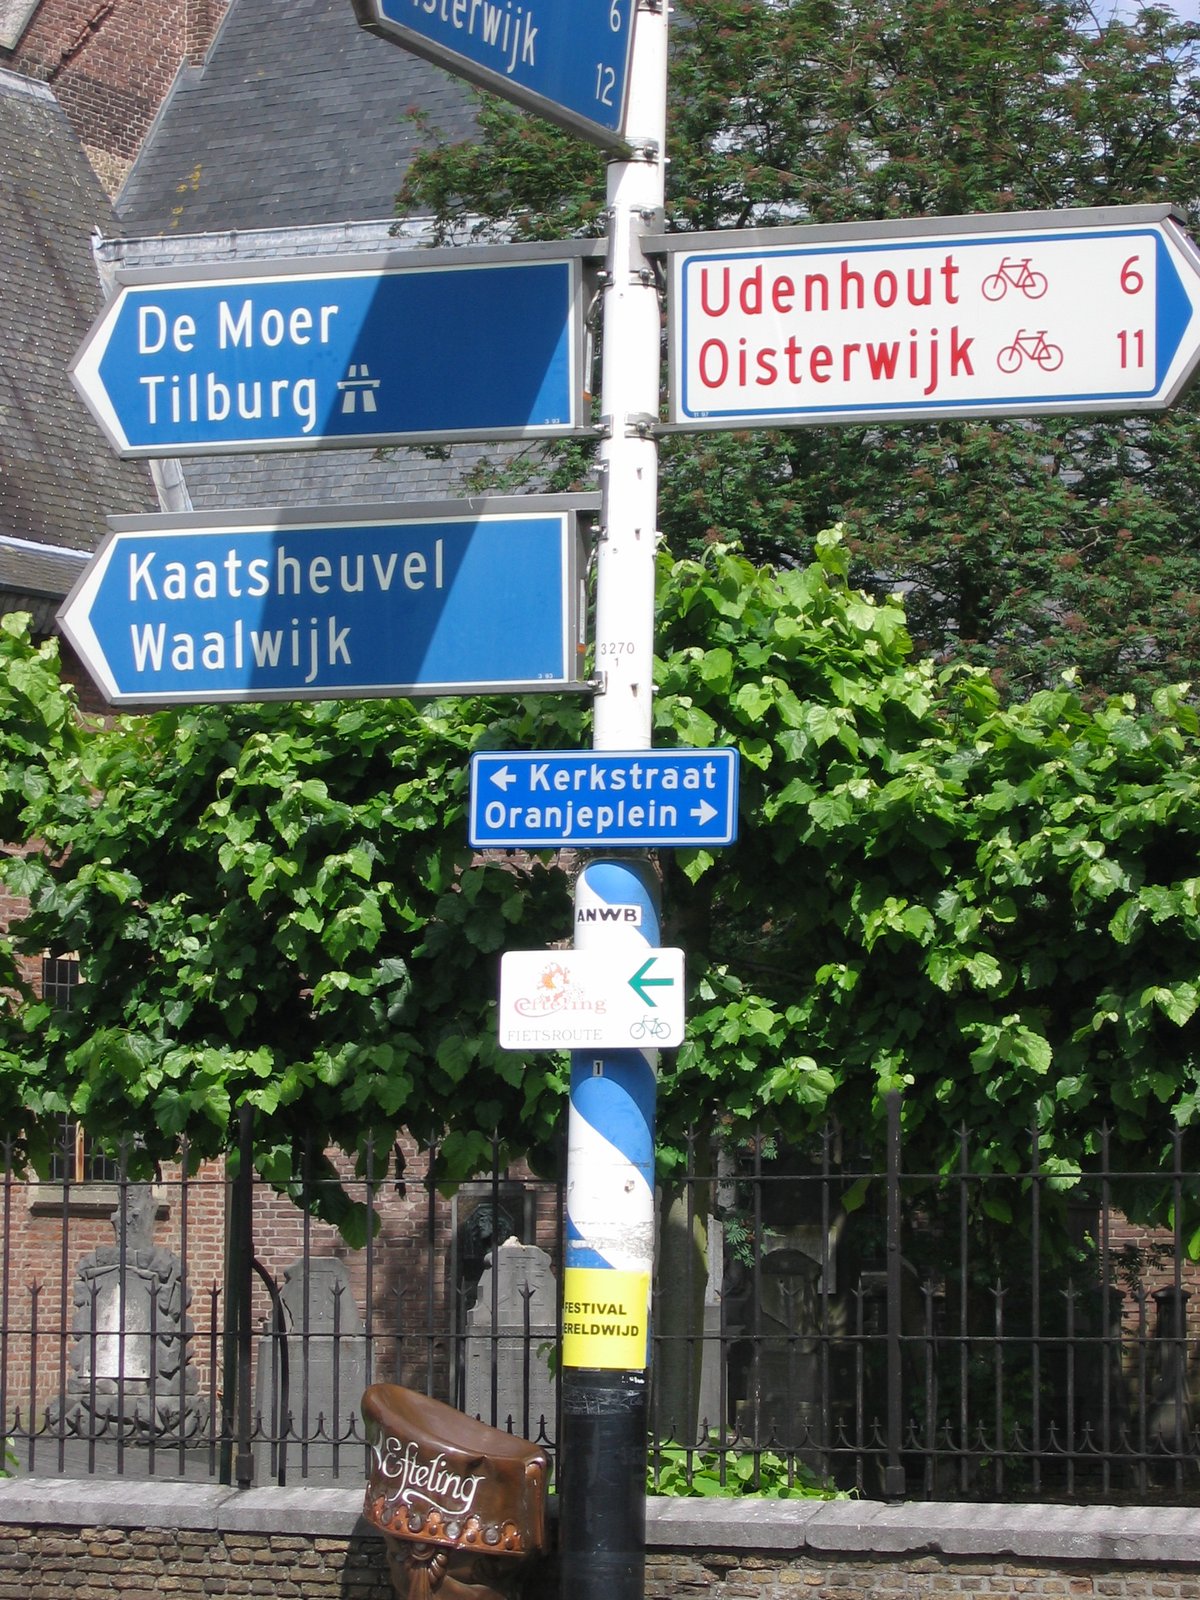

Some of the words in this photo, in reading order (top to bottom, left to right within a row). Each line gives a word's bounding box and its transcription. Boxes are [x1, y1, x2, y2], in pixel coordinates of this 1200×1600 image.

[609, 0, 622, 32] 6
[594, 62, 616, 107] 12
[700, 254, 960, 318] Udenhout
[1120, 254, 1145, 295] 6
[138, 304, 196, 355] De
[218, 299, 339, 350] Moer
[698, 324, 976, 396] Oisterwijk
[1116, 328, 1146, 369] 11
[139, 372, 317, 433] Tilburg
[129, 539, 444, 601] Kaatsheuvel
[130, 616, 353, 683] Waalwijk
[601, 641, 635, 656] 3270
[529, 761, 717, 792] Kerkstraat
[485, 799, 677, 837] Oranjeplein
[577, 907, 638, 923] ANWB
[507, 1029, 604, 1042] FIETSROUTE
[595, 1061, 601, 1075] 1
[564, 1301, 627, 1316] FESTIVAL
[563, 1322, 640, 1337] ERELDWIJD
[382, 1437, 486, 1515] Efteling
